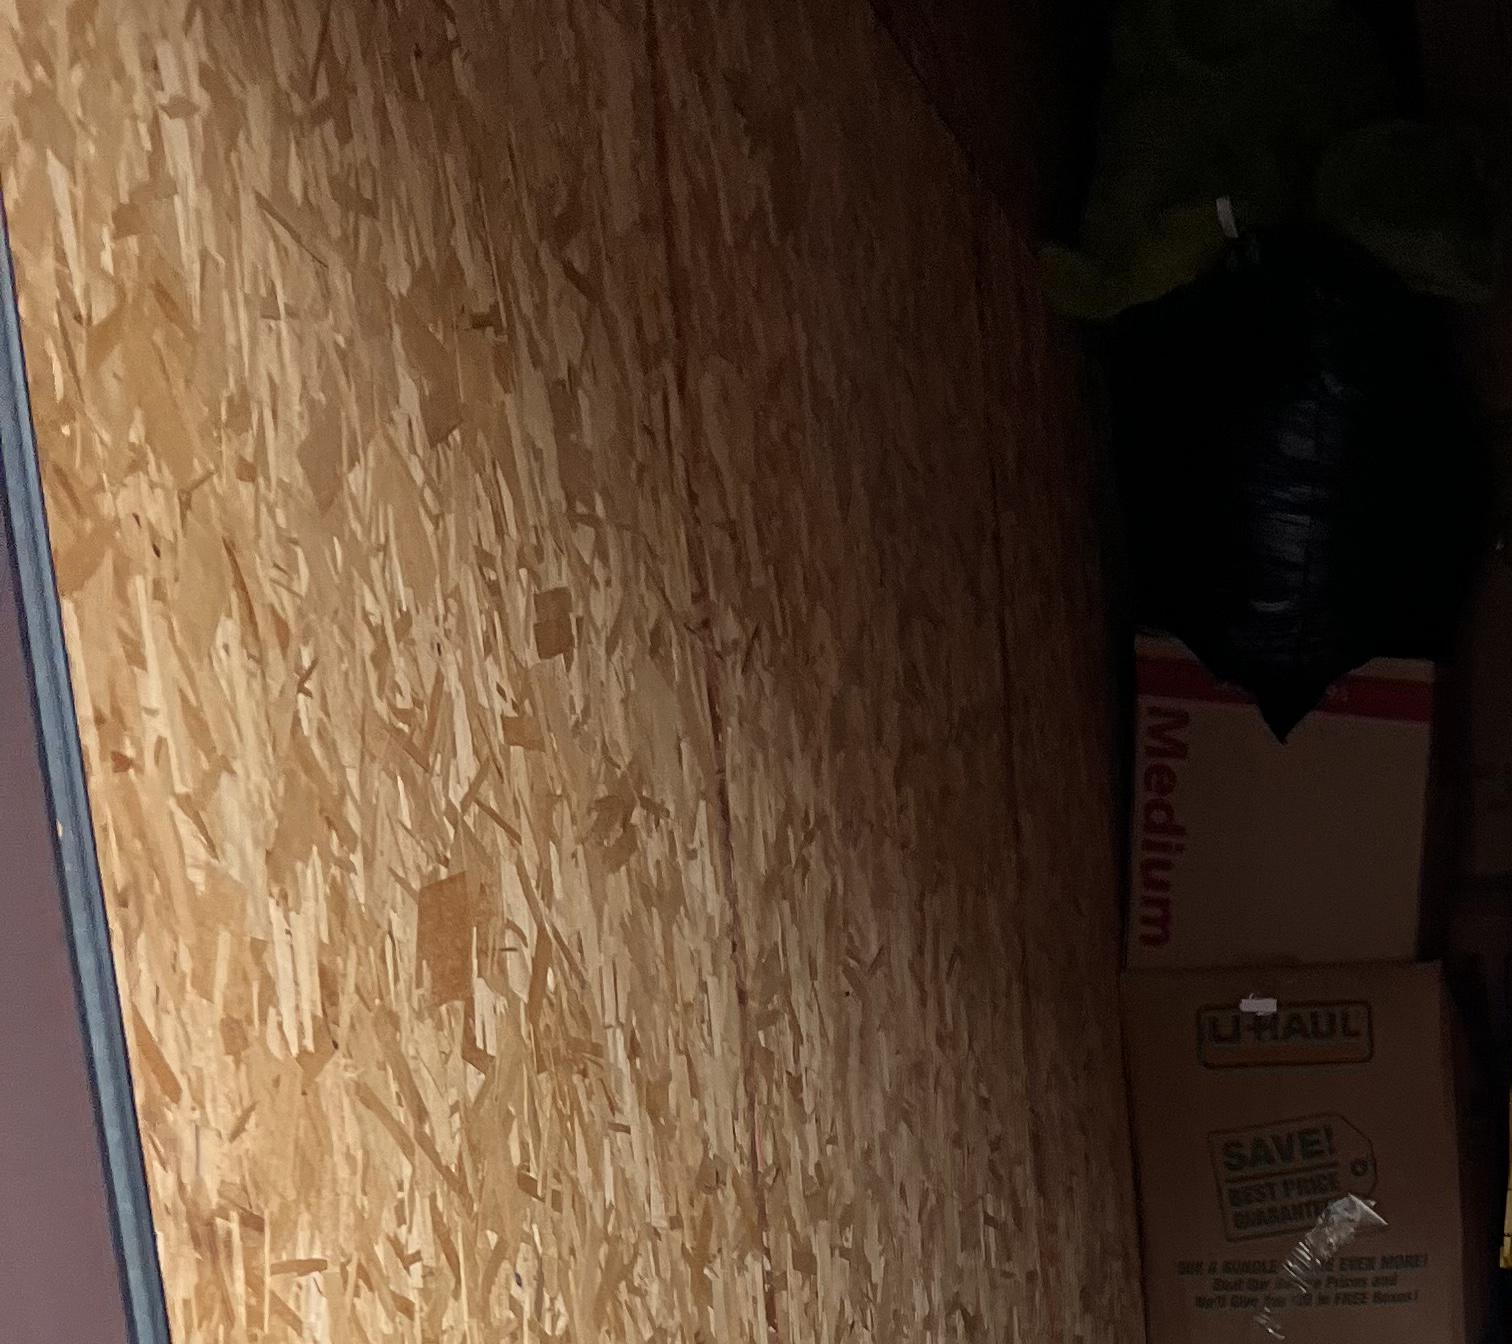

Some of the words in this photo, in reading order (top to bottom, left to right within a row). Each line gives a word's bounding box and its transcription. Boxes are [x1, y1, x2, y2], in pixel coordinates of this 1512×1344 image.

[1138, 705, 1192, 948] Medium
[1210, 1009, 1360, 1044] U-HAUL
[1223, 1127, 1336, 1171] SAVE!
